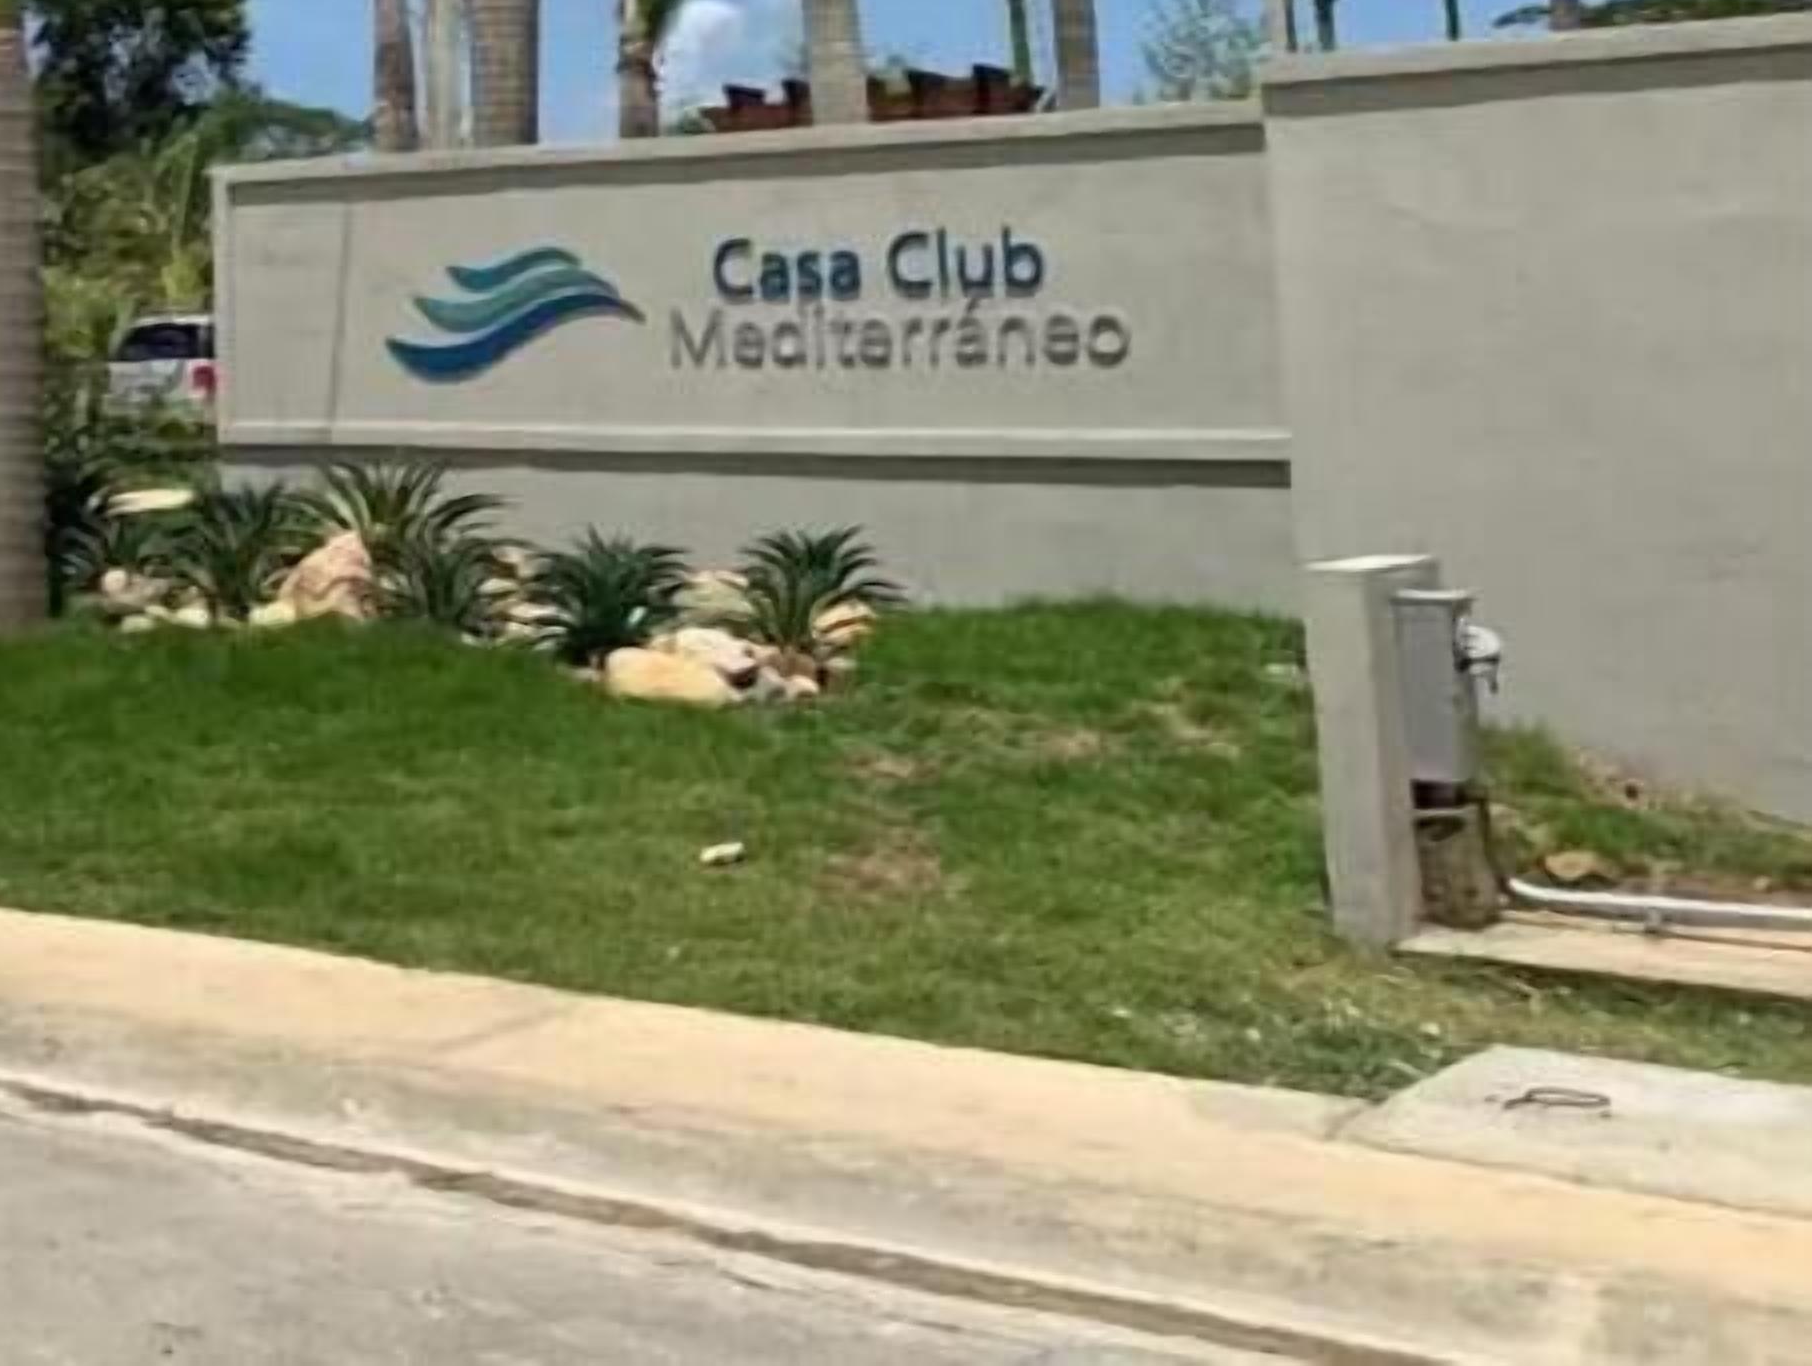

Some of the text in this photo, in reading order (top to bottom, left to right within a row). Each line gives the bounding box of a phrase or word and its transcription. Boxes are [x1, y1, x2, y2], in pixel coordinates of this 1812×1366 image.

[712, 224, 1045, 302] Casa Club
[669, 300, 1132, 370] Mediterráneo
